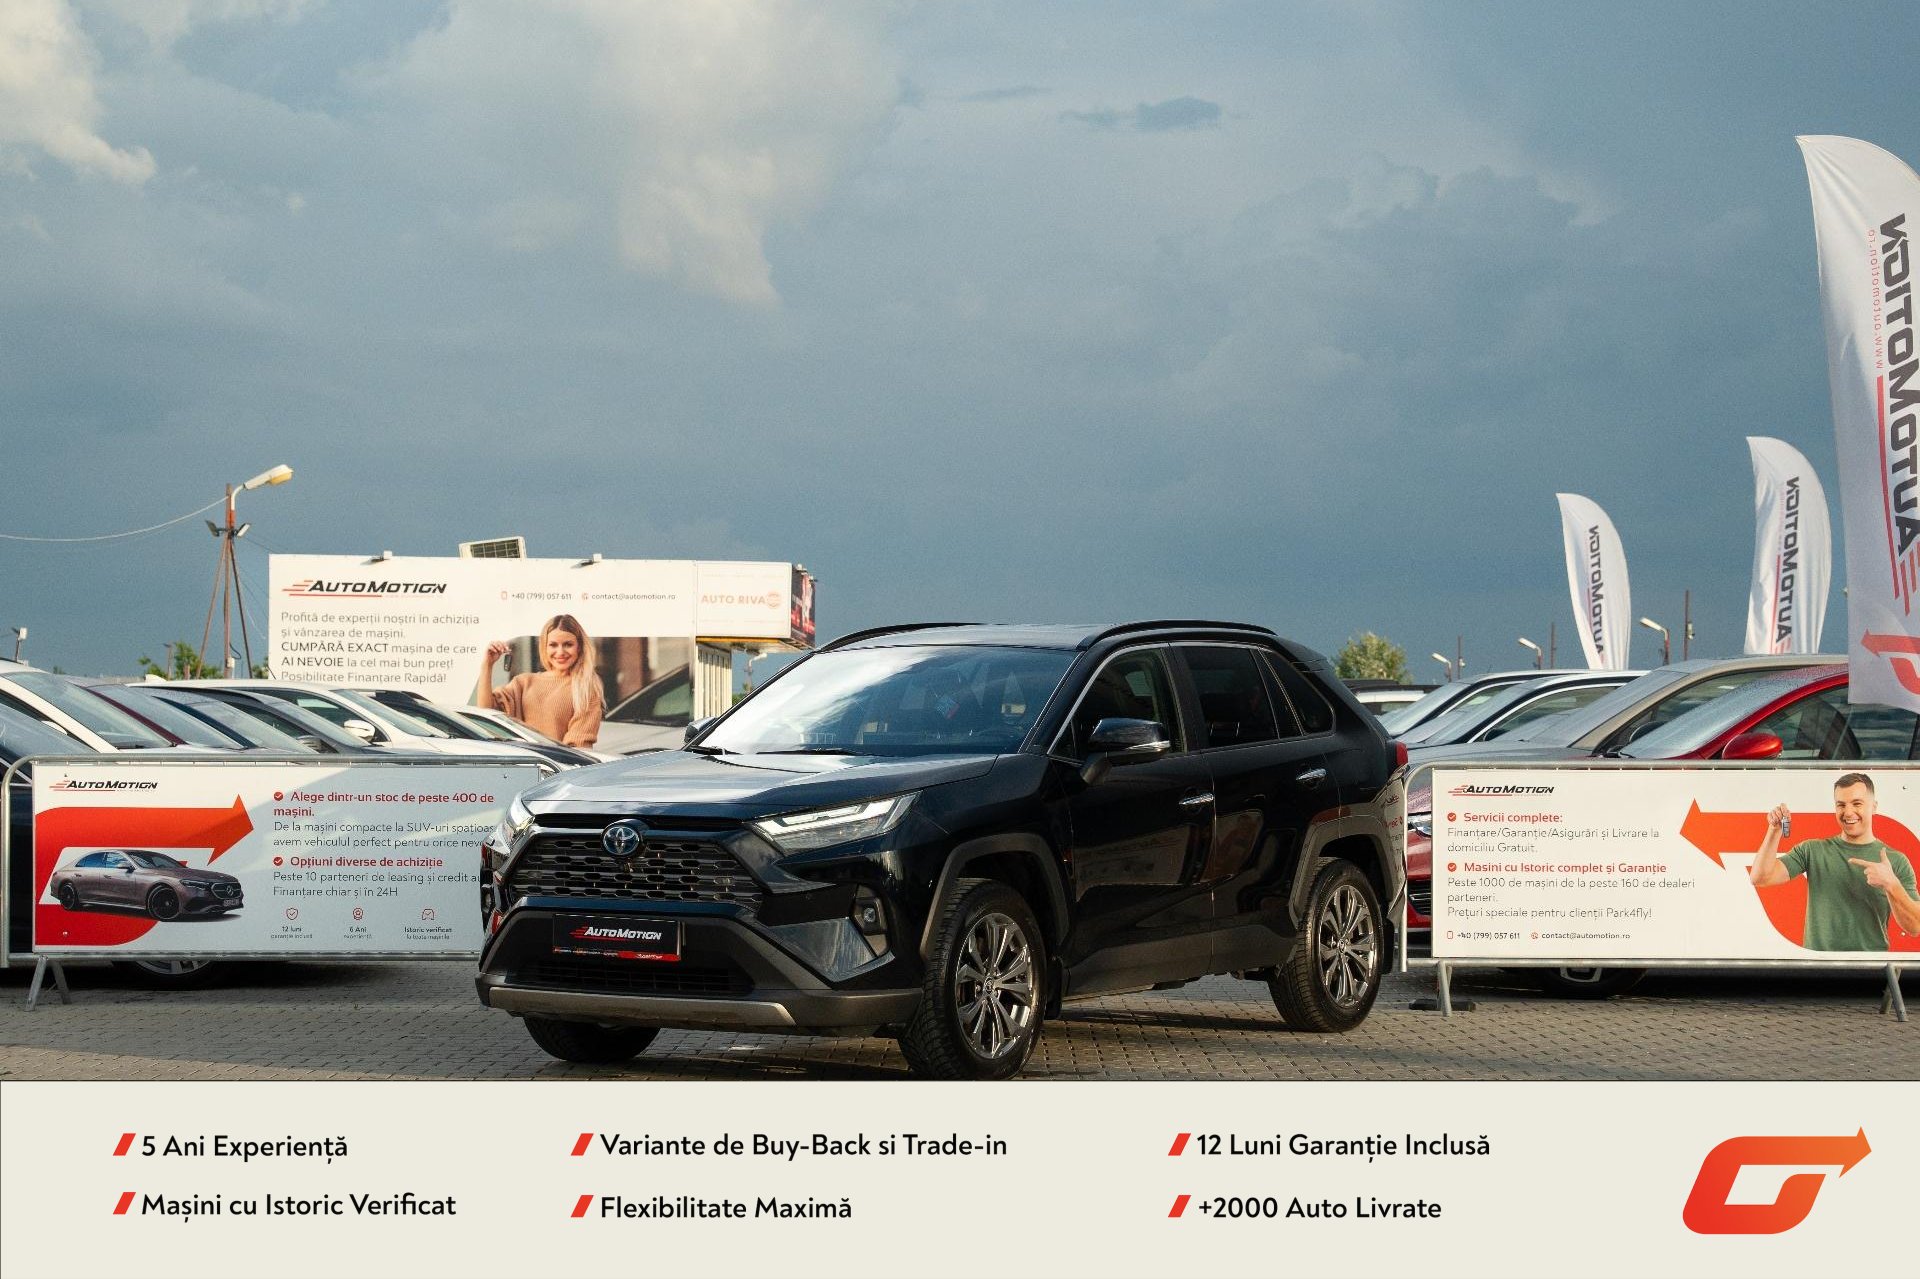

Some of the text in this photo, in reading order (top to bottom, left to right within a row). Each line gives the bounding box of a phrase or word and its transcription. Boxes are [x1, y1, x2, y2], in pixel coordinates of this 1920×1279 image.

[528, 592, 545, 600] (799)
[701, 595, 734, 605] AUTO
[322, 613, 335, 623] de
[384, 614, 416, 625] noștri
[432, 614, 479, 625] achiziția
[281, 628, 291, 638] și
[348, 628, 362, 638] de
[281, 640, 477, 654] CUMPĂRĂ EXACT mașina de care
[281, 656, 294, 666] AI
[297, 657, 344, 667] NEVOIE
[347, 657, 357, 667] la
[360, 658, 376, 667] cel
[379, 659, 400, 668] mai
[403, 658, 425, 668] bun
[281, 671, 344, 682] Posibilitate
[348, 672, 401, 684] Finanțare
[291, 791, 494, 804] Alege dintr-un stoc de peste 400 de
[274, 807, 314, 819] mașini.
[1464, 812, 1563, 825] Servicii complete:
[274, 822, 497, 836] De la mașini compacte la SUV-uri spațioas
[1612, 828, 1648, 838] Livrare
[1650, 828, 1660, 838] la
[274, 839, 301, 847] avem
[305, 837, 350, 847] vehiculul
[353, 837, 391, 849] perfect
[395, 838, 429, 850] pentru
[433, 838, 458, 848] orice
[1447, 843, 1538, 853] domiciliu Gratuit.
[290, 857, 443, 869] Opțiuni diverse de achiziție
[1505, 865, 1517, 873] cu
[1520, 862, 1554, 873] Istoric
[1557, 862, 1603, 875] complet
[1618, 863, 1667, 875] Garanție
[274, 872, 302, 881] Peste
[306, 872, 317, 881] 10
[320, 872, 368, 884] parteneri
[372, 872, 385, 882] de
[388, 872, 424, 884] leasing
[437, 873, 468, 882] credit
[1448, 878, 1695, 890] Peste 1000 de mașini de la peste 160 de dealeri
[274, 887, 322, 898] Finanțare
[325, 887, 351, 896] chiar
[376, 887, 398, 896] 24H
[1447, 893, 1498, 904] parteneri.
[1448, 907, 1652, 920] Prețuri speciale pentru clienții Park4fly!
[1473, 931, 1492, 940] (799)
[1494, 931, 1507, 939] 057
[1542, 931, 1631, 940] contact@automotion.ro
